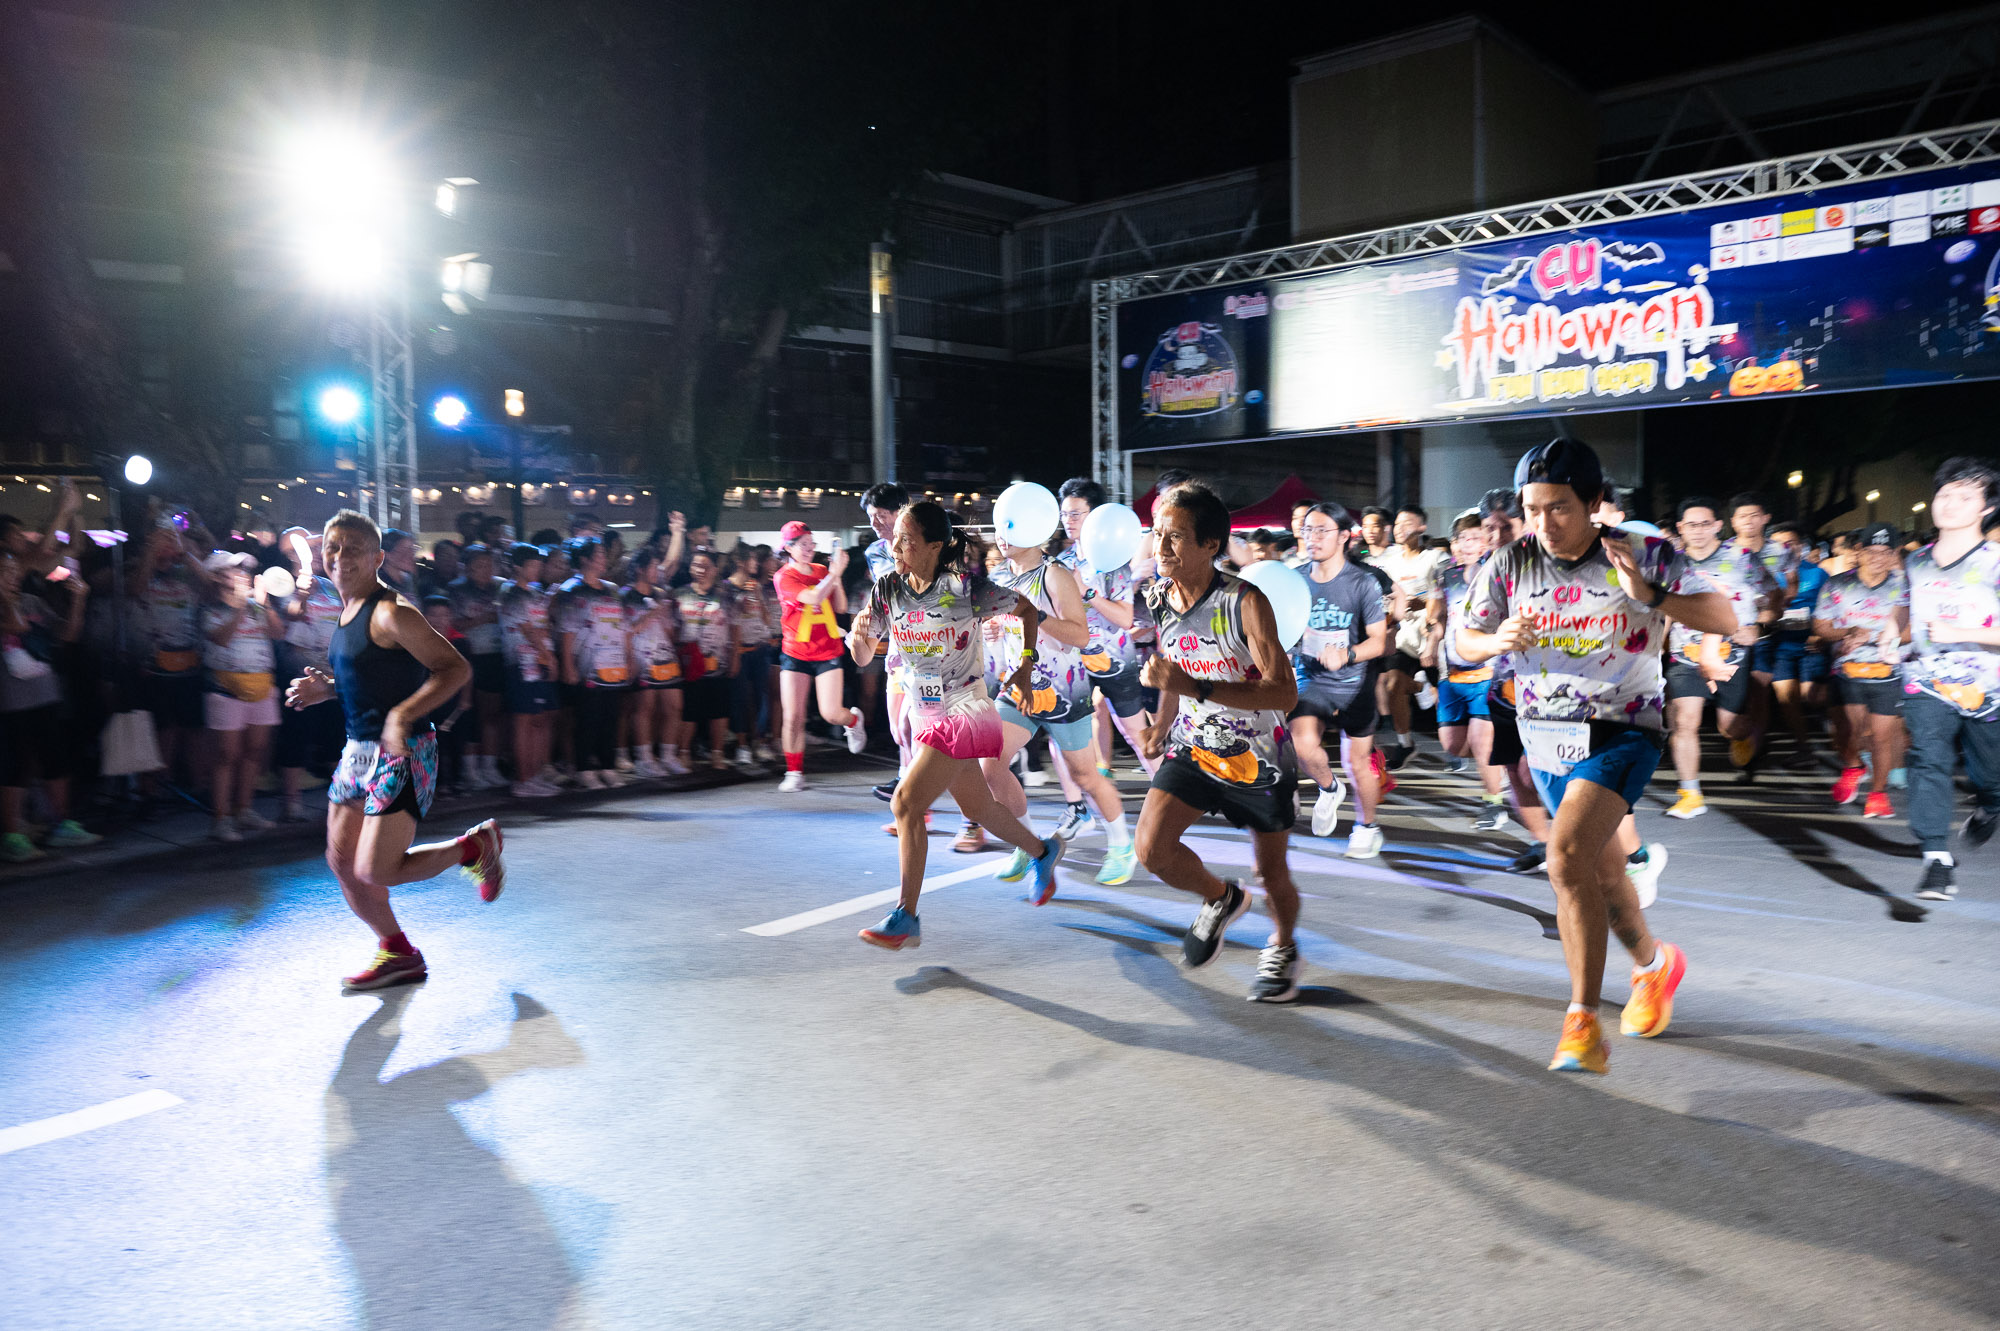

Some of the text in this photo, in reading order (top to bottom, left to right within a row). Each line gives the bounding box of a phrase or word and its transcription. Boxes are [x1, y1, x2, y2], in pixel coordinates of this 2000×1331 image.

[1534, 240, 1599, 295] CU
[1448, 289, 1708, 386] Halloween
[1553, 585, 1582, 604] CU
[907, 611, 924, 624] CU
[892, 624, 955, 648] Halloween
[1179, 635, 1199, 652] CU
[1168, 654, 1239, 680] lloween
[919, 686, 941, 697] 182
[1557, 744, 1585, 761] 028
